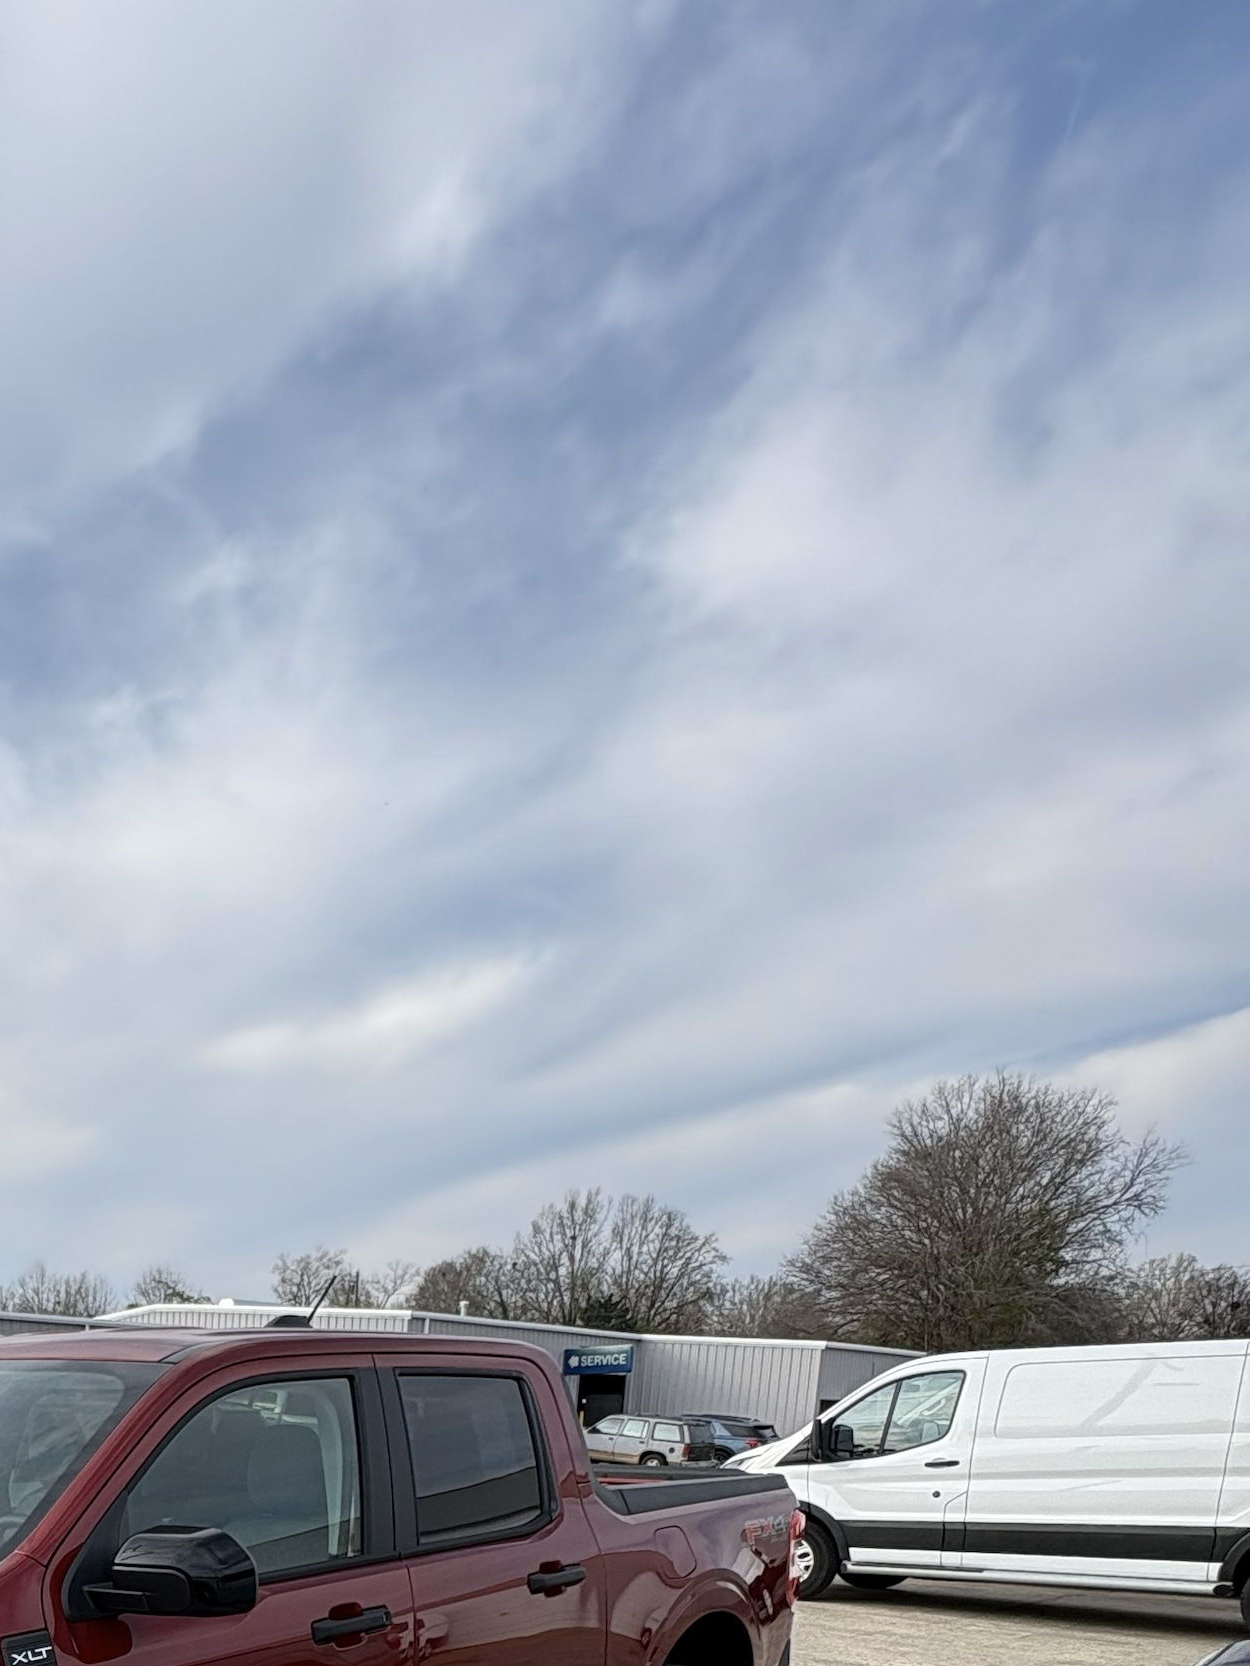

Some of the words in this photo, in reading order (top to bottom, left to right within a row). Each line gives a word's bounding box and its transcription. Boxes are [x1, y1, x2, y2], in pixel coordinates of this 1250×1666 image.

[580, 1353, 628, 1367] SERVICE
[744, 1514, 786, 1545] FX4
[10, 1646, 53, 1666] XLT
